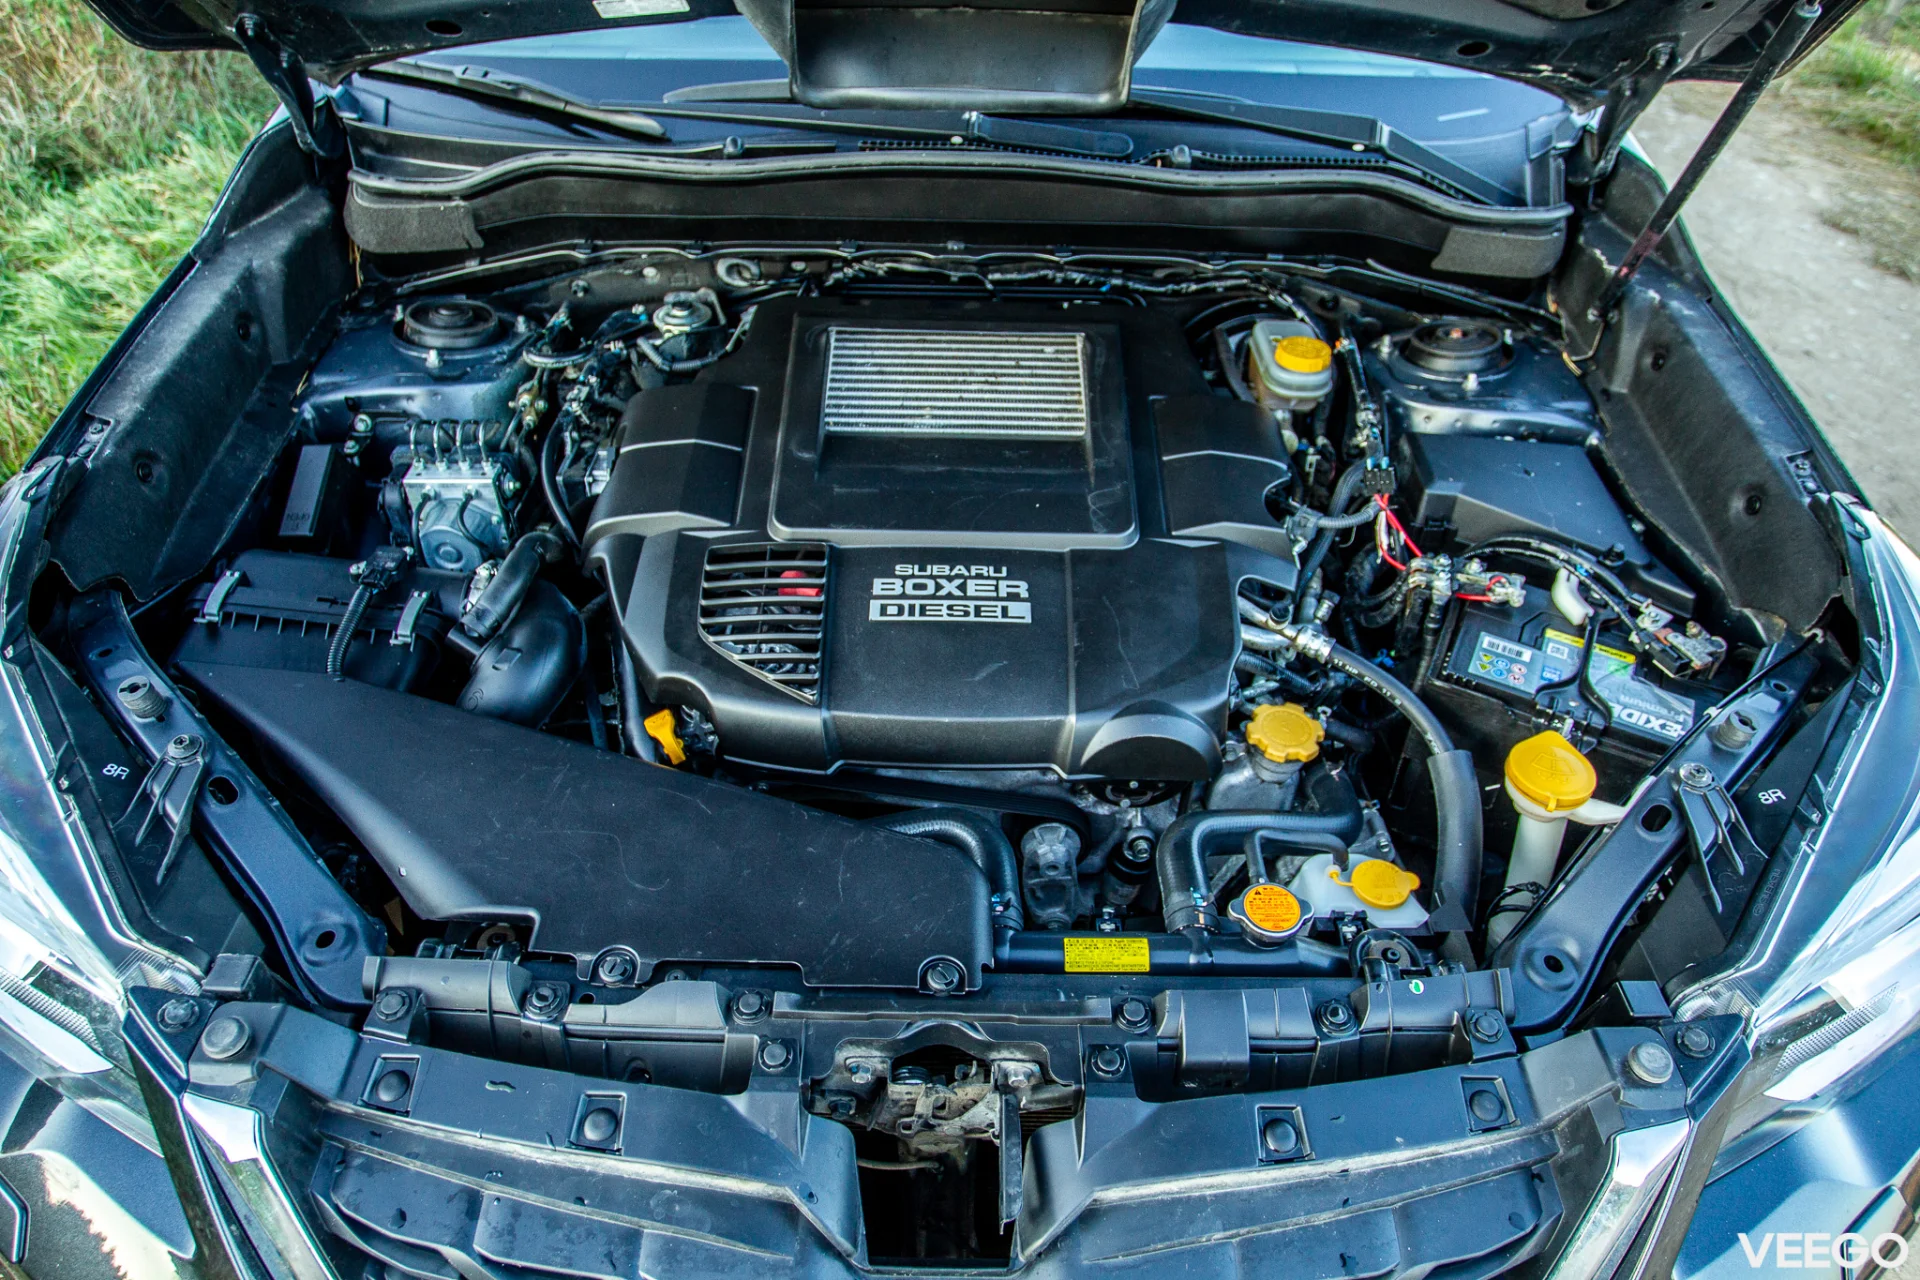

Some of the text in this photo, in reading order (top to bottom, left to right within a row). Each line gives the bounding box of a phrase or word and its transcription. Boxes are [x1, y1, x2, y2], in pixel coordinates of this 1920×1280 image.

[895, 564, 1007, 577] SUBARU
[872, 578, 1029, 598] BOXER
[879, 602, 1026, 620] DIESEL
[1619, 694, 1686, 723] Premium
[102, 763, 130, 780] 8R
[1758, 788, 1787, 805] 8R
